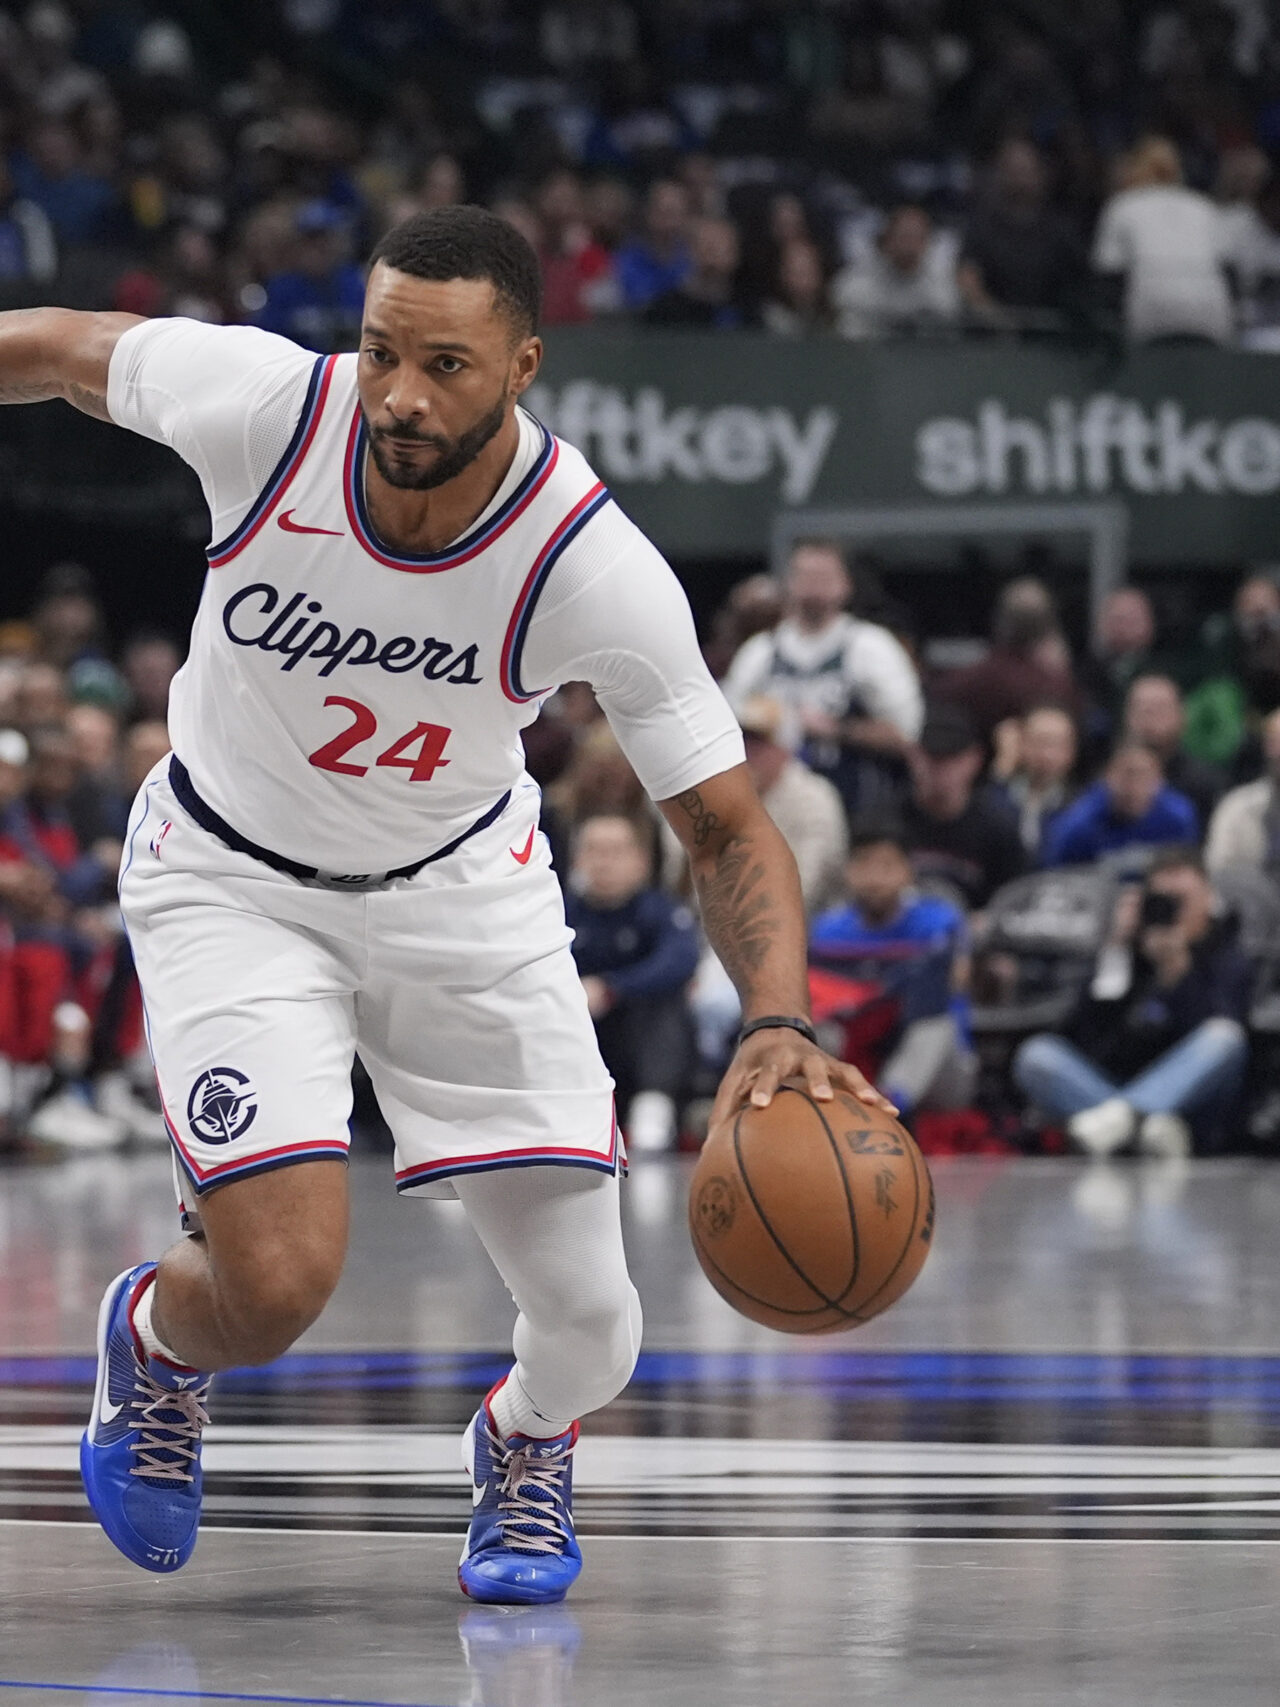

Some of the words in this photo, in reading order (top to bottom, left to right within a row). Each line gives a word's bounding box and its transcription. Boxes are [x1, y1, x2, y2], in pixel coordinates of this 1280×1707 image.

[523, 377, 840, 501] iftkey
[222, 582, 484, 685] Clippers
[308, 695, 452, 782] 24
